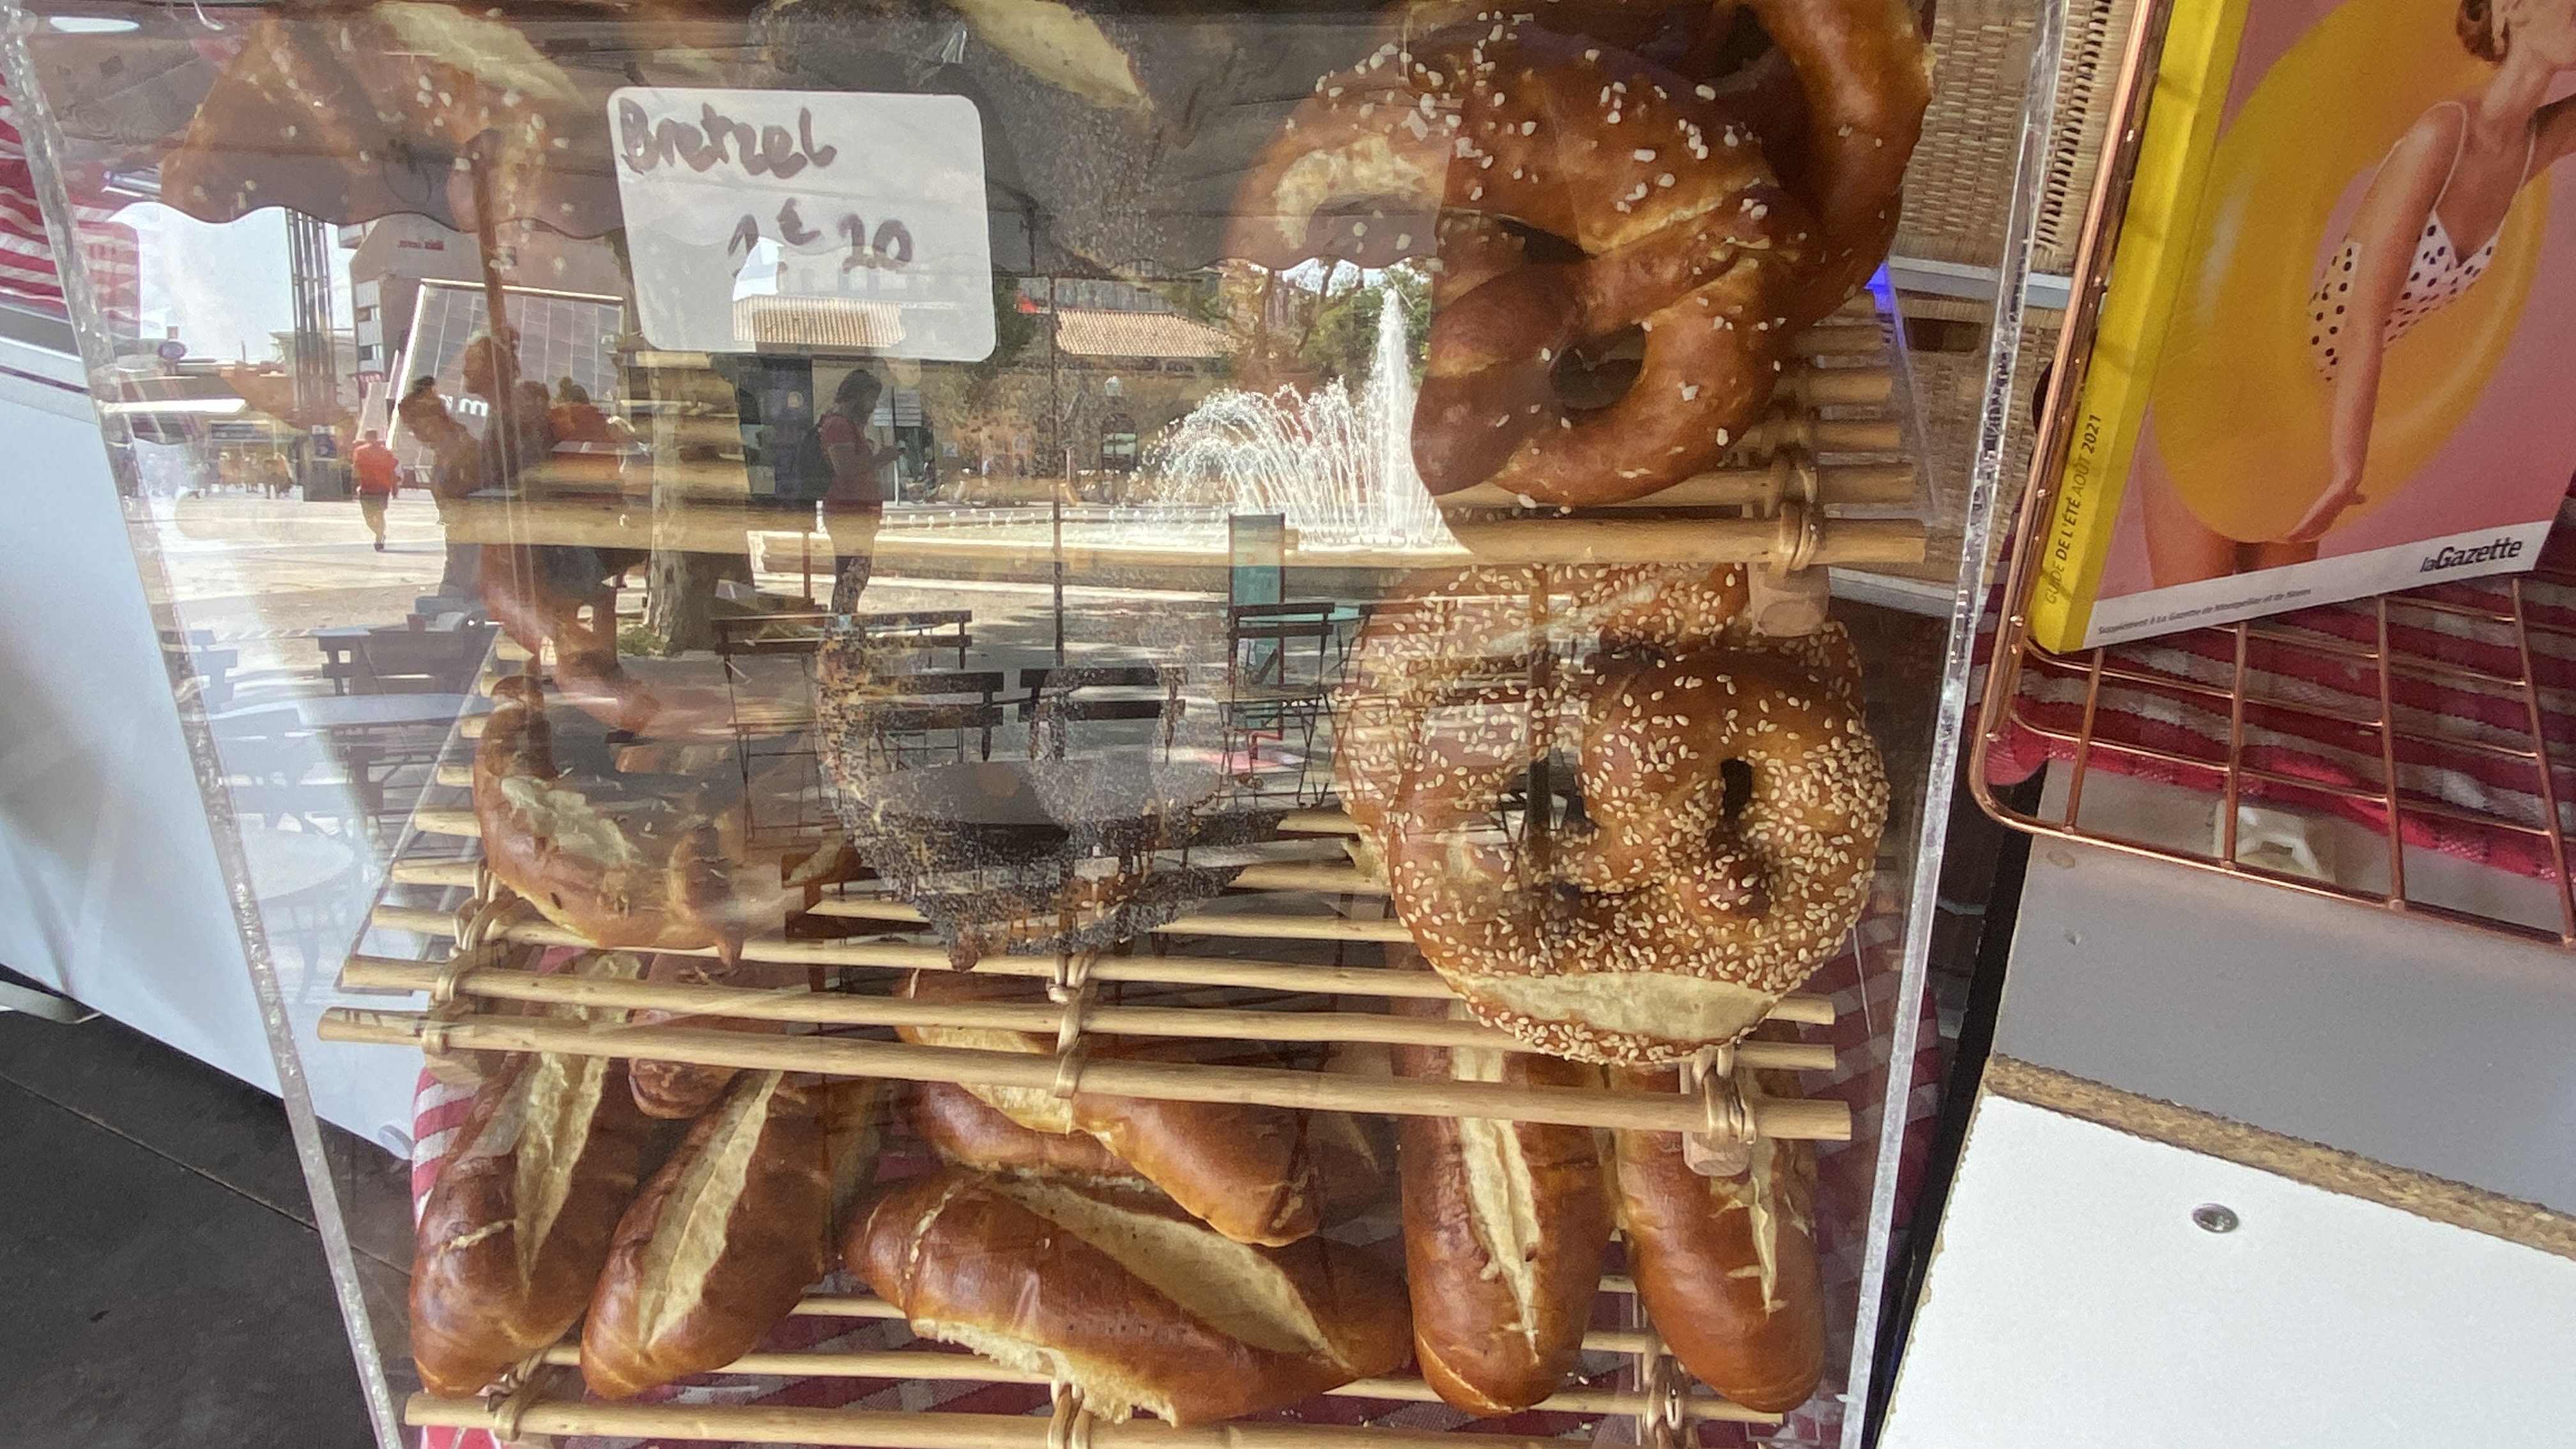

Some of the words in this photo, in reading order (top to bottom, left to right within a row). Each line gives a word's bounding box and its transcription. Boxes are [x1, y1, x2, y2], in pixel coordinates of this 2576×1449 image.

[2081, 414, 2101, 454] 2021
[2061, 496, 2081, 539] L'ÉTÉ
[2055, 539, 2071, 561] DE
[2044, 560, 2065, 604] GUIDE
